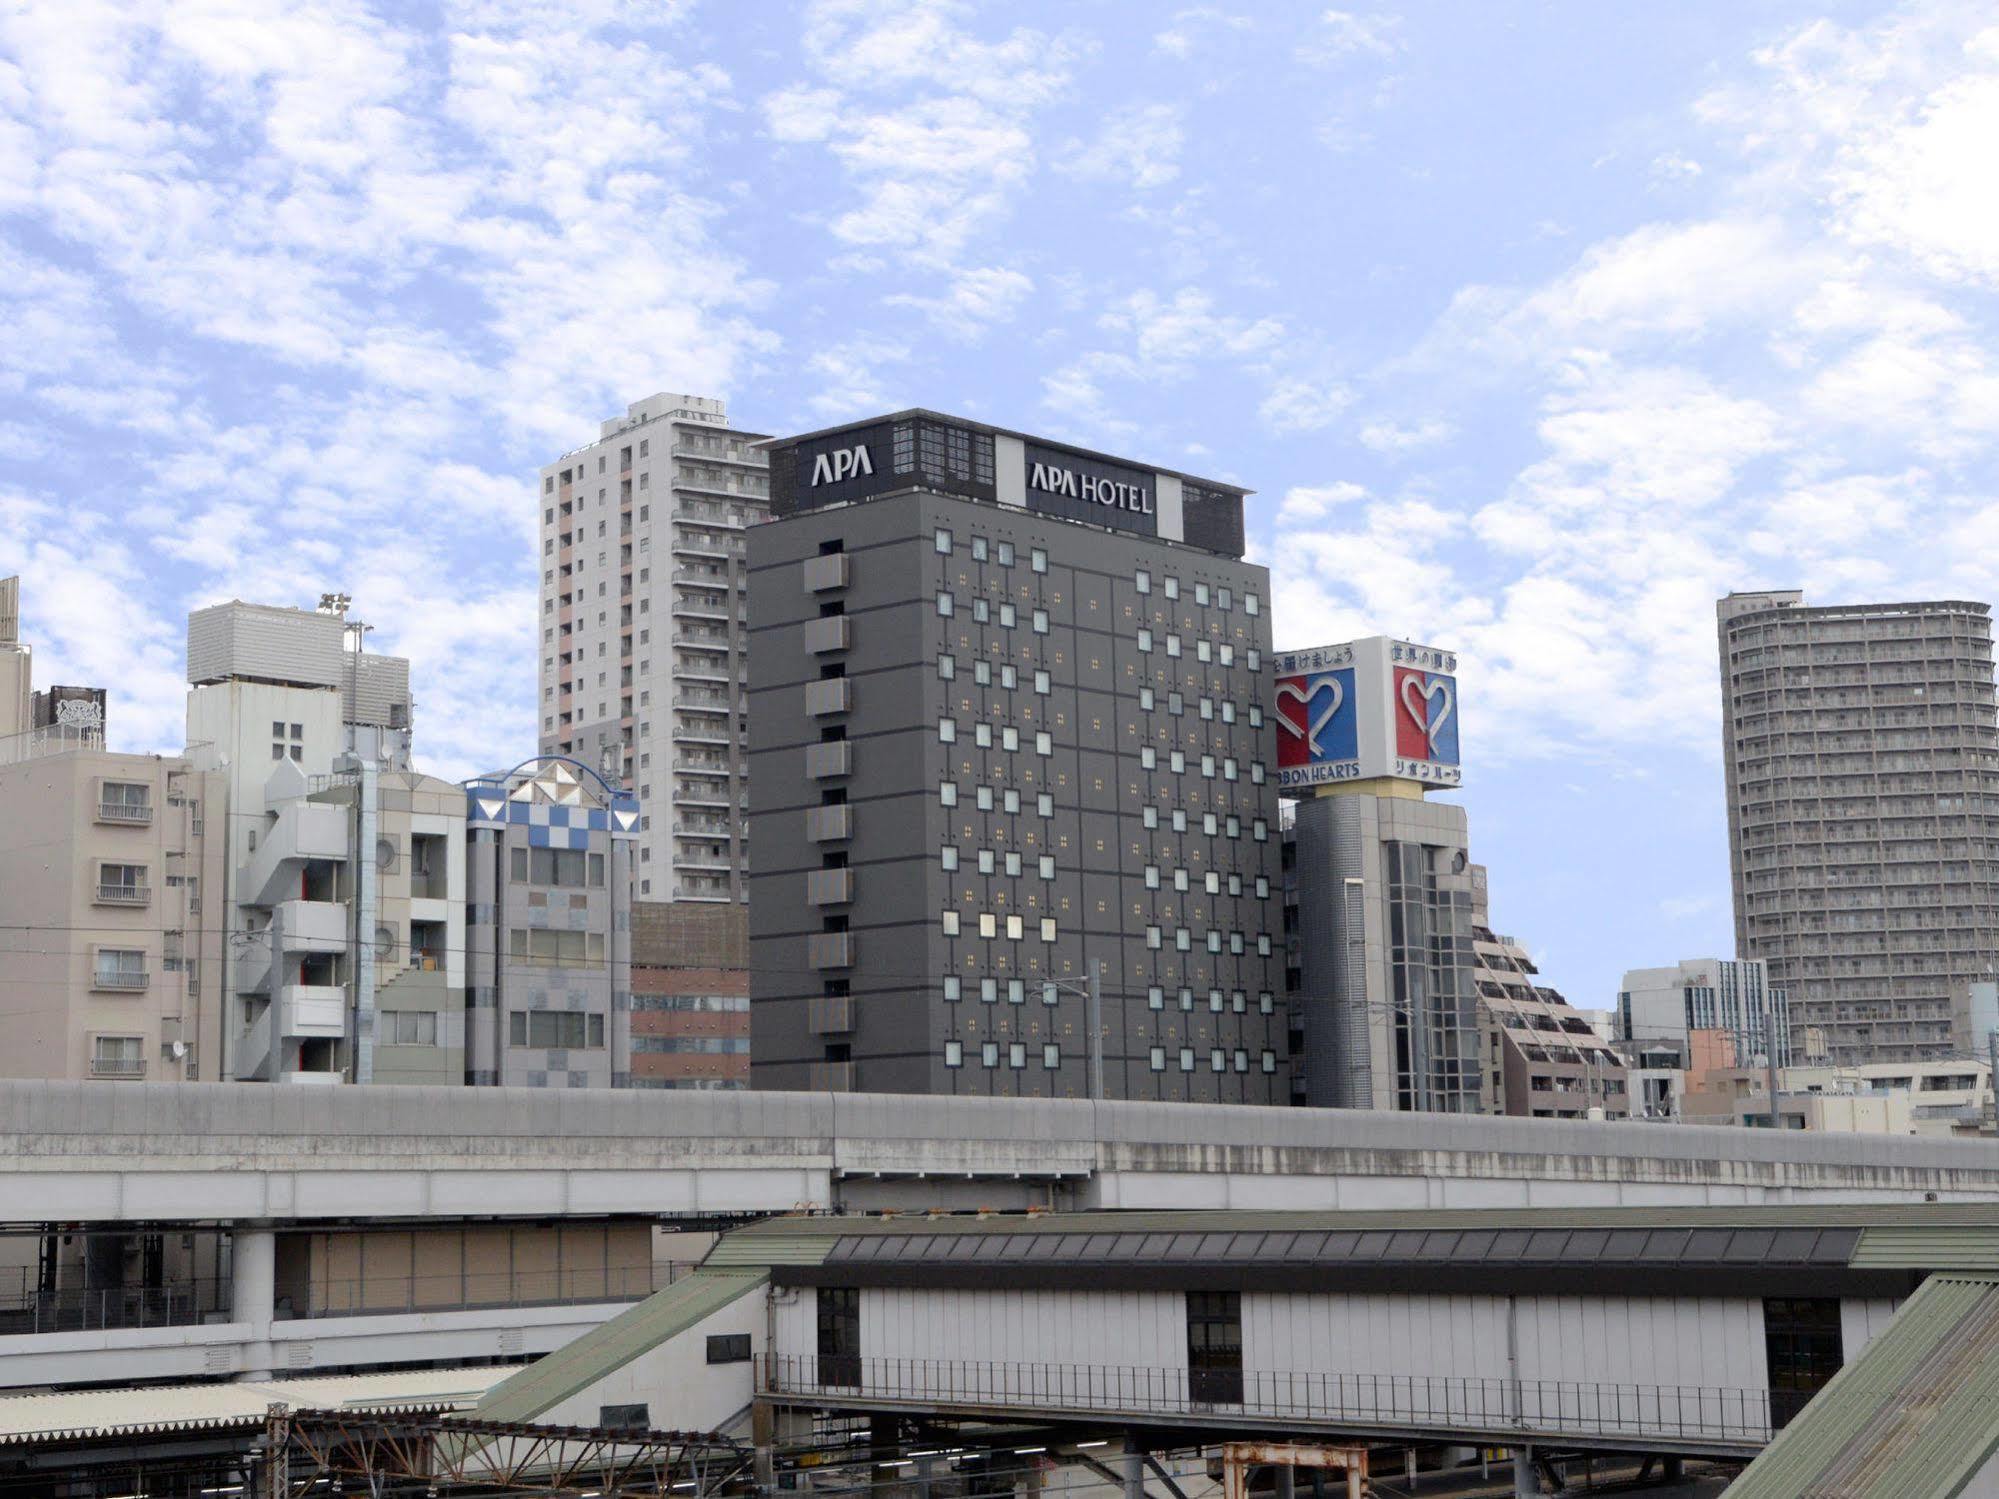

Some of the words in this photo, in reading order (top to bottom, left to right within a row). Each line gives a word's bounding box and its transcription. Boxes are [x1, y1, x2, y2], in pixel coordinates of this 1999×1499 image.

[811, 445, 873, 487] APA
[1031, 462, 1077, 497] APA
[1081, 474, 1153, 514] HOTEL
[1312, 763, 1360, 782] HEARTS
